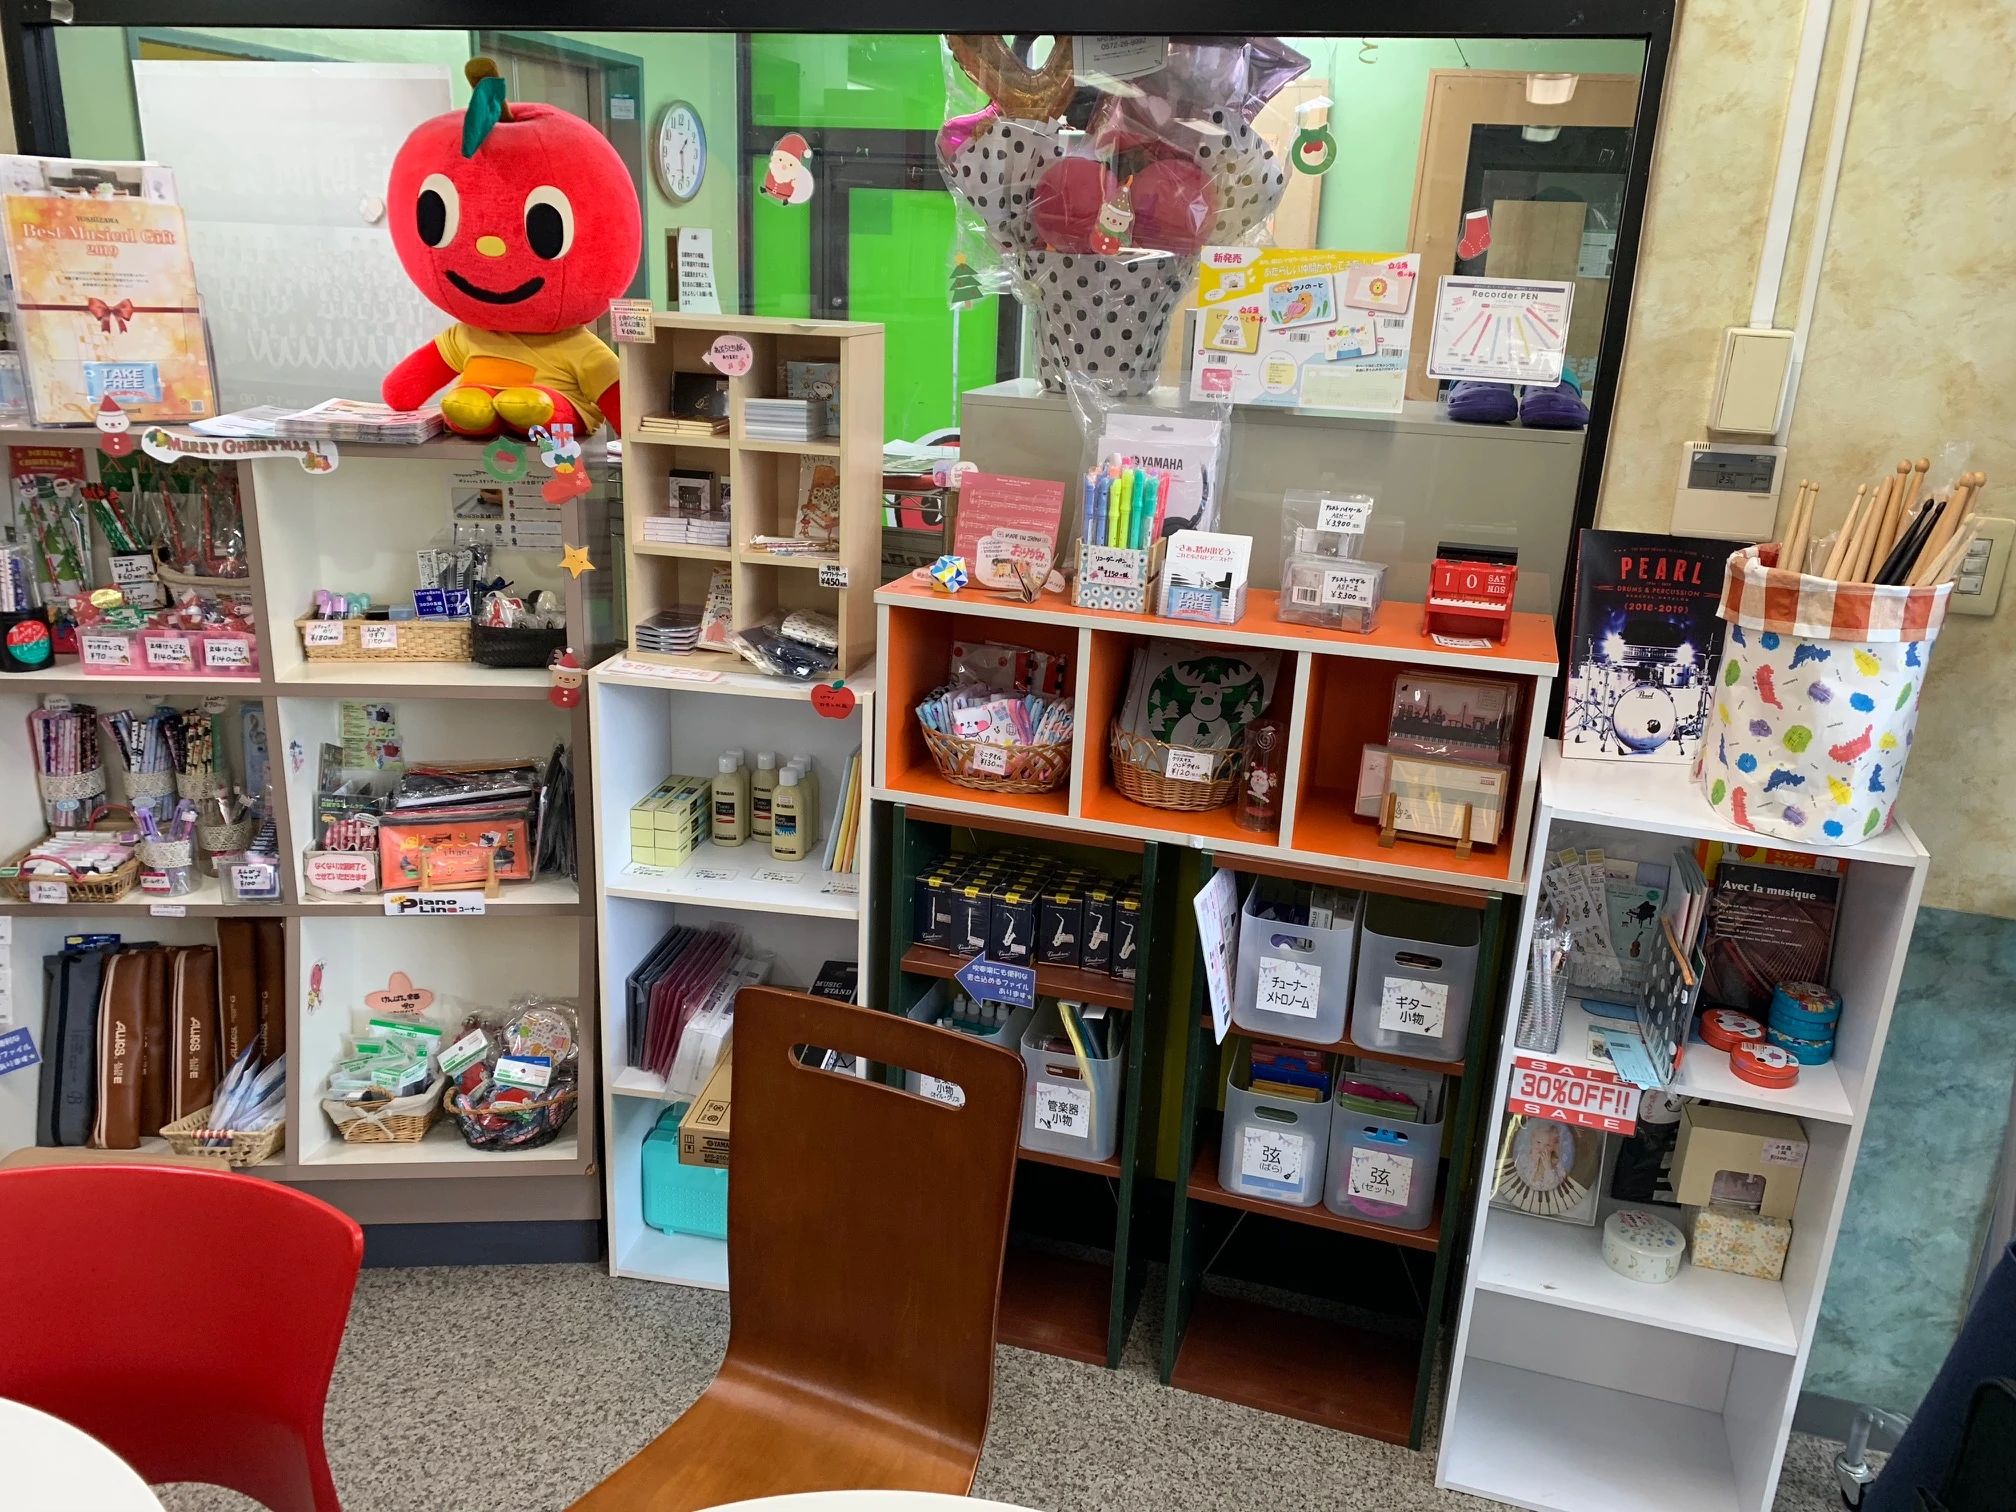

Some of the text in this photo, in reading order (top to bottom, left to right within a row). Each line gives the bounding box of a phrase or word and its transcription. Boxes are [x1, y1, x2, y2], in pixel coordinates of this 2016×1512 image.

[22, 223, 177, 245] Best Musical Gift
[1213, 253, 1243, 264] 新発売
[1472, 290, 1539, 300] Recorder PEN
[101, 368, 145, 379] TAKE
[105, 379, 145, 389] FREE
[167, 437, 219, 454] MERRY
[222, 438, 312, 455] CHRISTMAS
[1141, 456, 1184, 471] YAMAHA
[1010, 544, 1046, 561] おりがみ
[1488, 574, 1506, 583] SAT
[1621, 557, 1702, 585] PEARL
[820, 578, 840, 587] ¥450
[1178, 591, 1213, 602] TAKE
[1616, 585, 1641, 593] DRUMS
[1652, 588, 1700, 596] PERCUSSION
[1179, 600, 1211, 612] FREE
[1722, 880, 1817, 900] Avec la musique
[814, 980, 843, 990] MUSIC
[967, 973, 1029, 991] 書き込めるファイル
[1271, 976, 1308, 991] チューナー
[823, 987, 852, 996] STAND
[1266, 992, 1310, 1010] メトロノーム
[1395, 996, 1432, 1011] ギター
[1399, 1012, 1425, 1026] 小物
[114, 1020, 127, 1056] AULOS
[189, 1016, 201, 1052] AULOS
[936, 1084, 954, 1096] 小物
[1520, 1073, 1630, 1115] 30%OFF!!
[1047, 1100, 1079, 1116] 管楽器
[1051, 1113, 1073, 1127] 小物
[1523, 1103, 1620, 1130] SALE
[1262, 1146, 1282, 1165] 弦
[1258, 1162, 1283, 1175] (ばら)
[1369, 1167, 1392, 1187] 弦
[1360, 1182, 1396, 1197] (セット)
